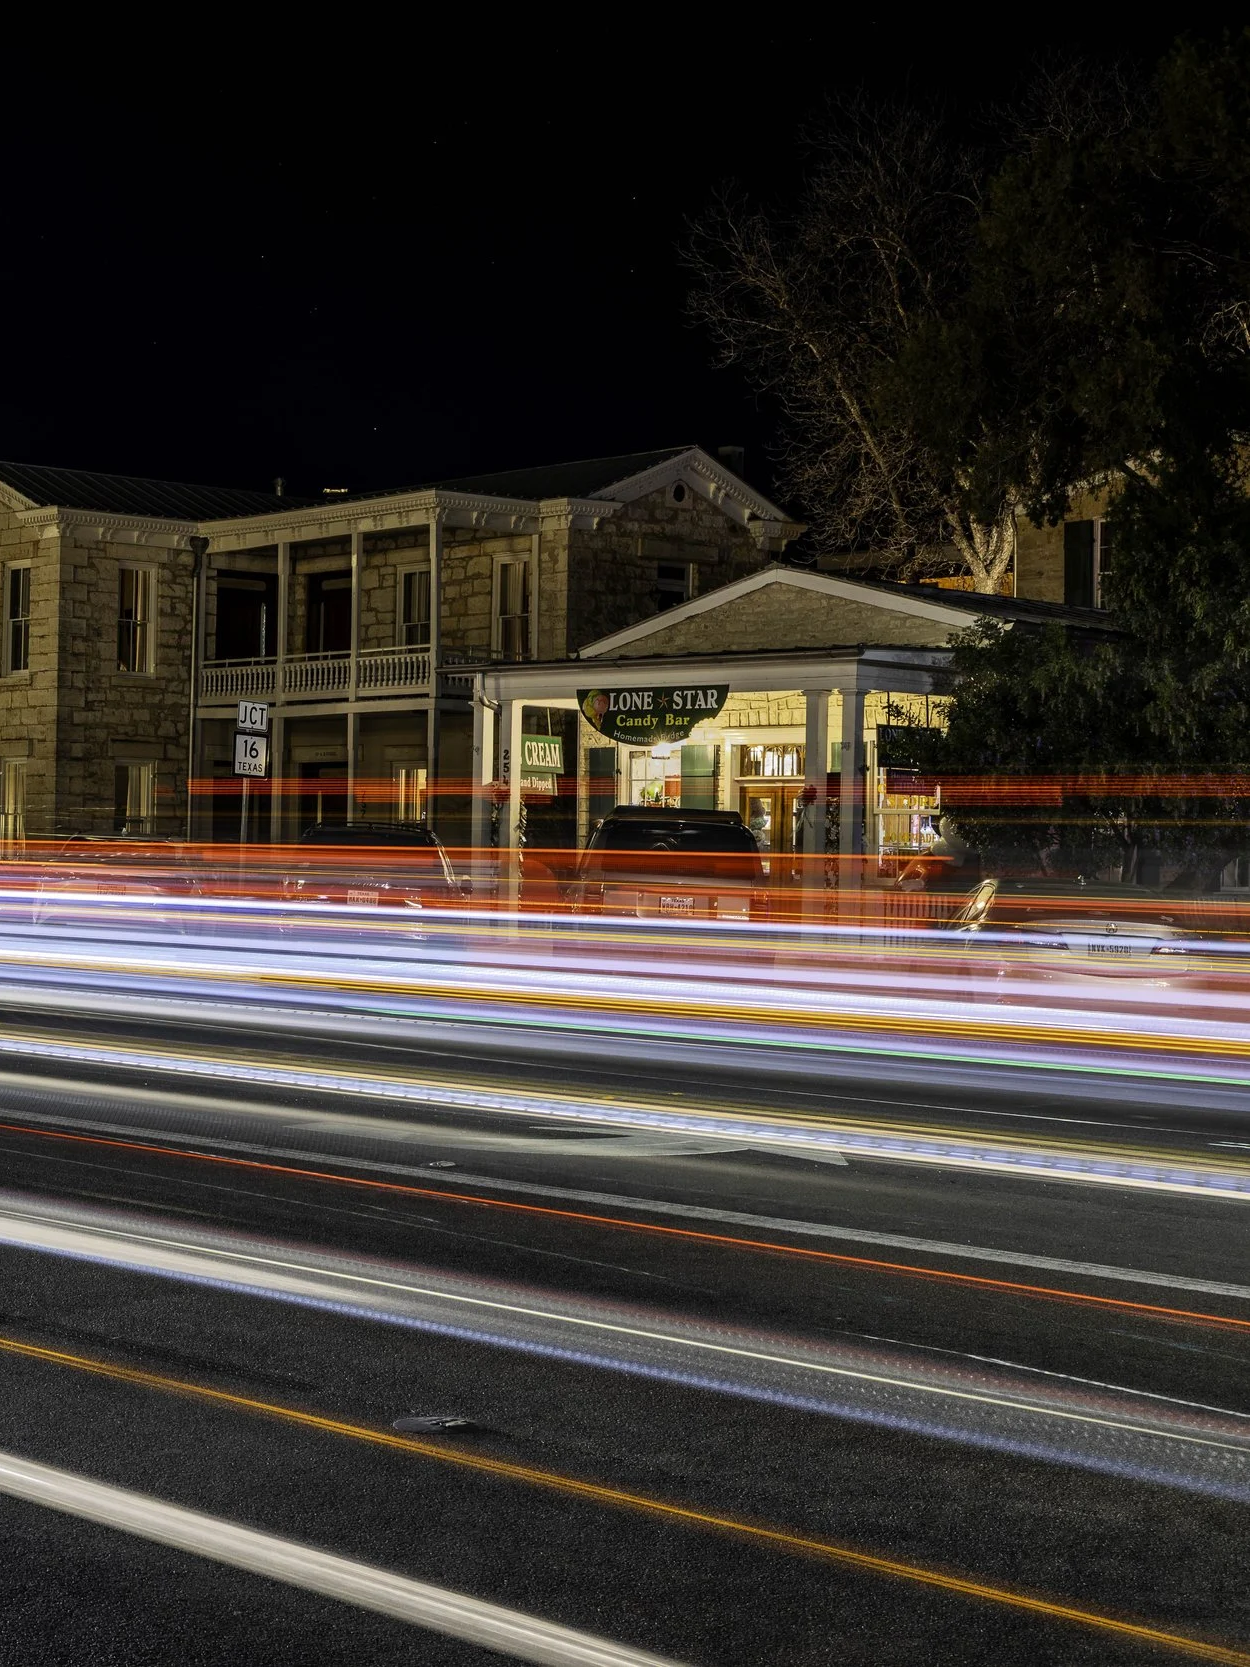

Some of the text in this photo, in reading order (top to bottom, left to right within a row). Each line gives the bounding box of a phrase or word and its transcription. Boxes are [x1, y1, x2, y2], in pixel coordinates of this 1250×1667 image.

[608, 689, 719, 711] LONE STAR
[239, 705, 266, 726] JCT
[616, 713, 691, 730] Candy Bar
[243, 739, 259, 759] 16
[525, 741, 561, 768] CREAM
[238, 761, 263, 773] TEXAS
[520, 776, 553, 791] and Dipped
